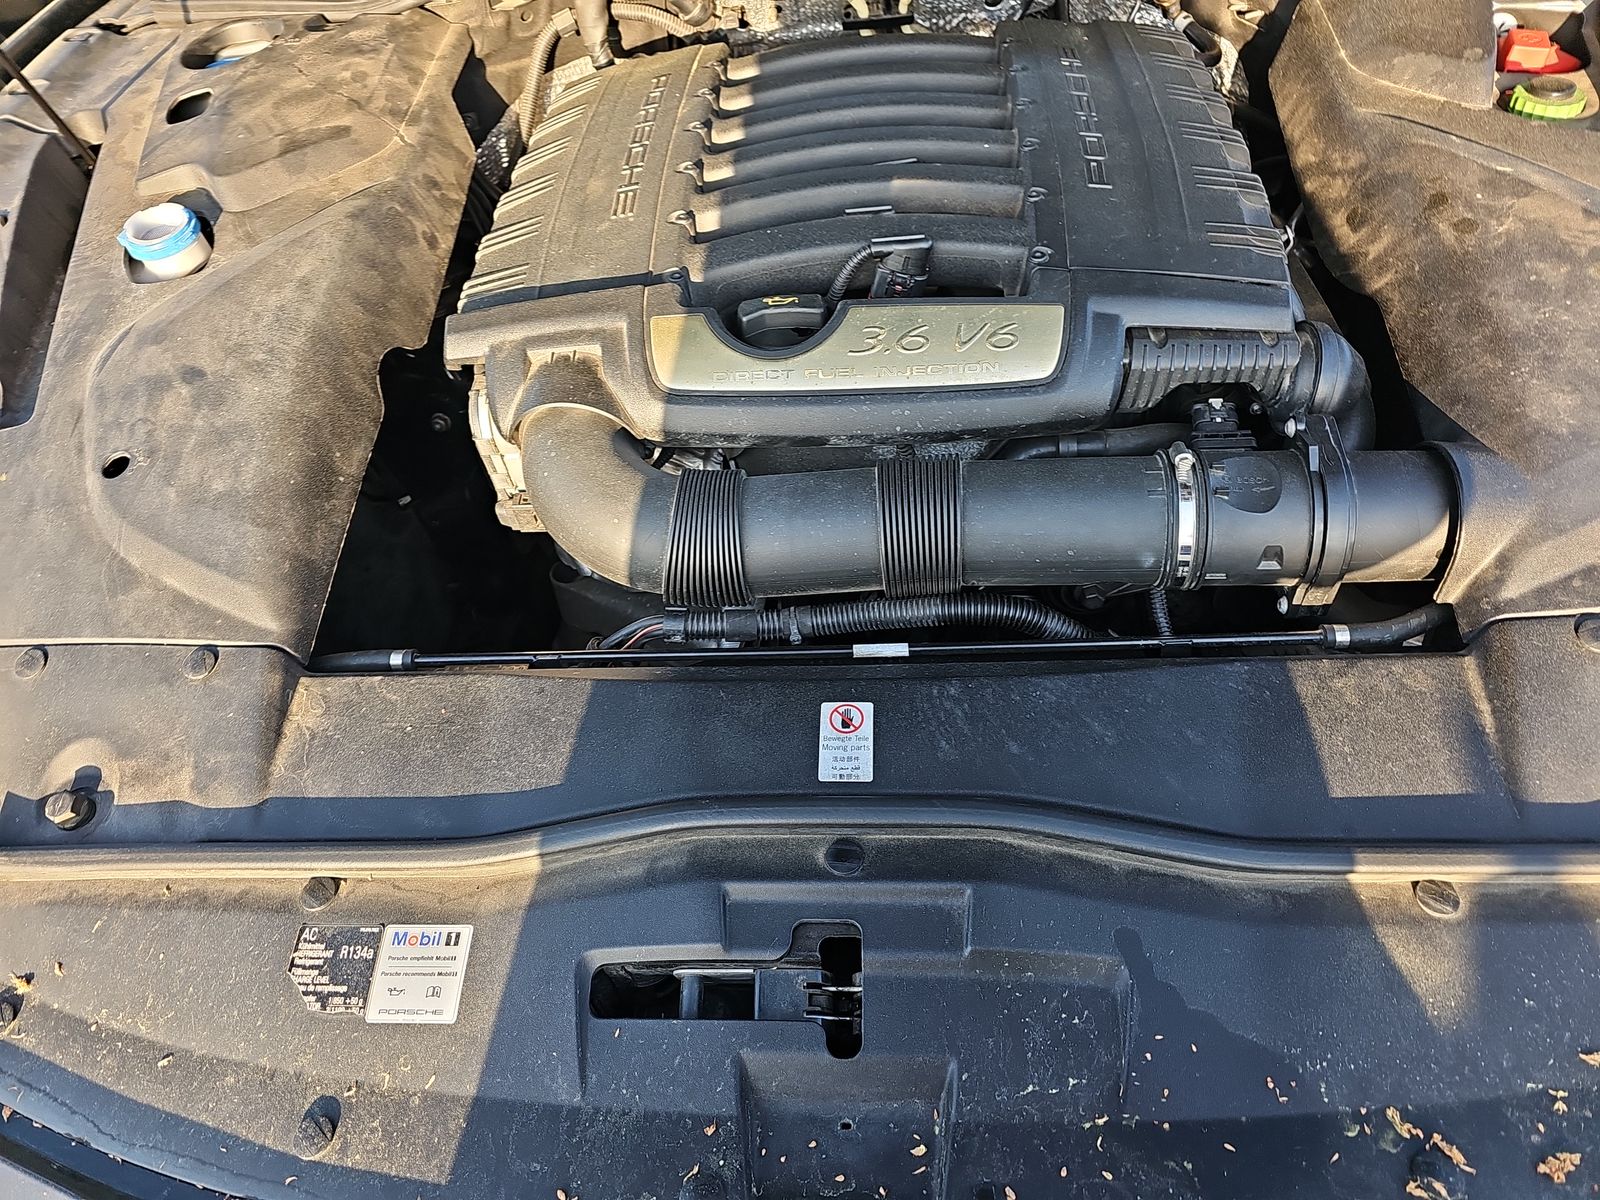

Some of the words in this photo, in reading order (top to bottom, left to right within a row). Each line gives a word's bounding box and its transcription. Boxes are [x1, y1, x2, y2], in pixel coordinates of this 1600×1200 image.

[1056, 46, 1113, 190] PORSCHE
[611, 73, 672, 220] PORSCHE
[848, 324, 930, 356] 3.6
[955, 321, 1020, 352] V6
[712, 368, 795, 384] DIRECT
[804, 365, 864, 381] FUEL
[874, 360, 1000, 378] INJECTION
[823, 735, 853, 743] Bewegte
[822, 744, 849, 752] Moving
[851, 744, 871, 752] parts
[300, 927, 318, 941] AC
[392, 931, 442, 946] Mobil
[340, 945, 374, 960] R134a
[378, 1008, 444, 1016] PORSCHE
